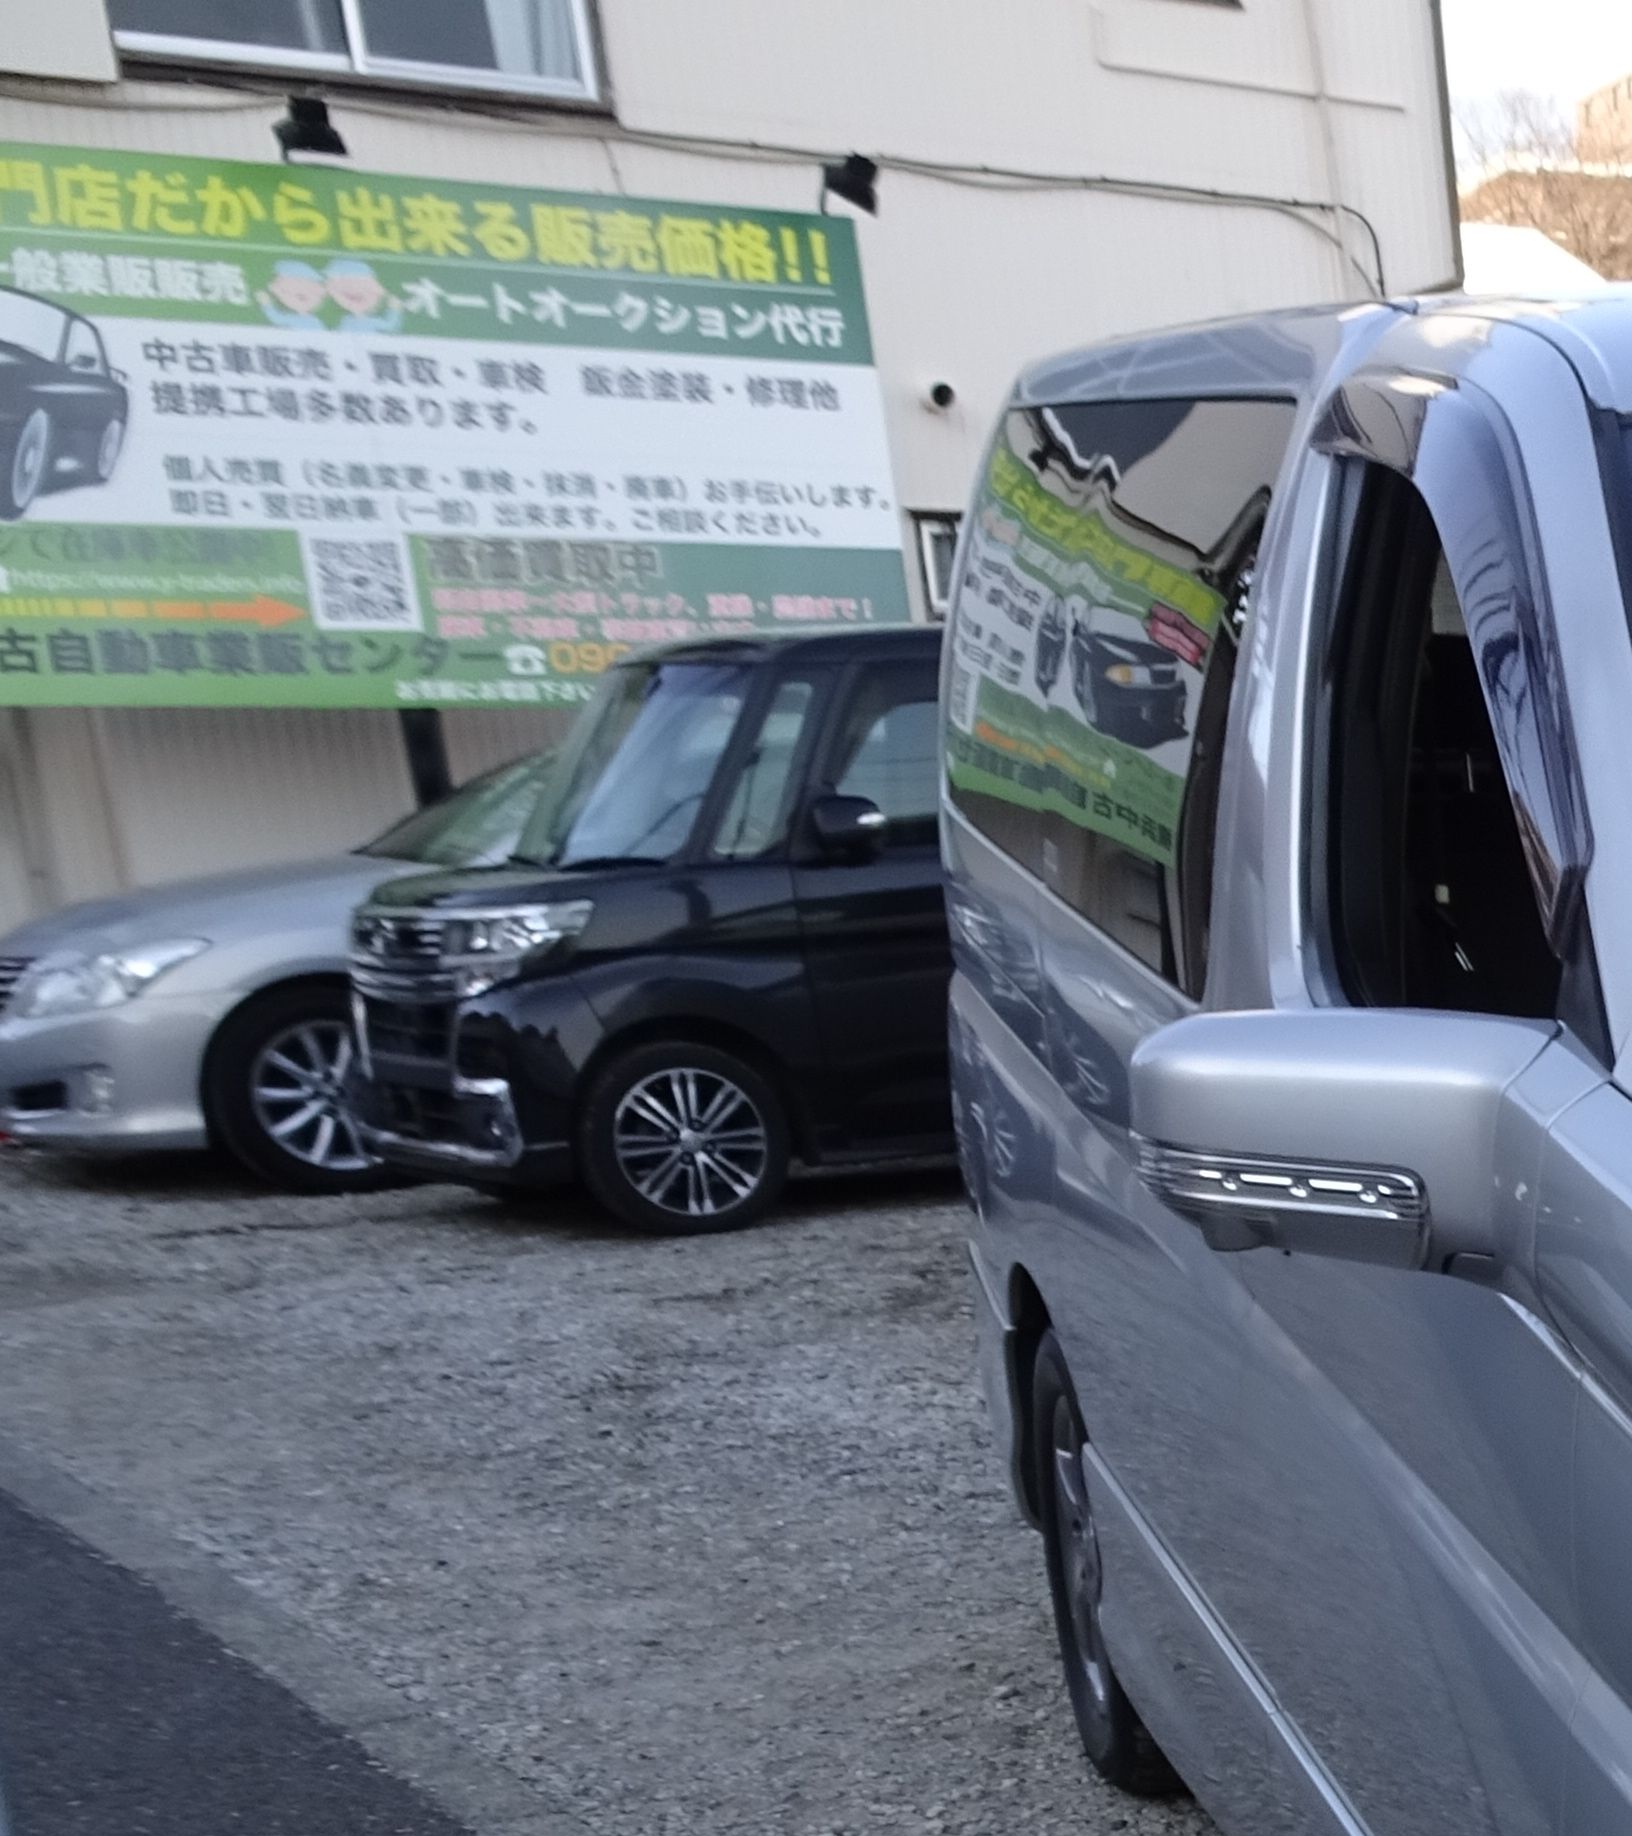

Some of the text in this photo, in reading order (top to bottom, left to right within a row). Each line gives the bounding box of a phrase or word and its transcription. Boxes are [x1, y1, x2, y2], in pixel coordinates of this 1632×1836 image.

[0, 247, 249, 305] 般業販販売
[402, 277, 846, 348] オートオークション代行
